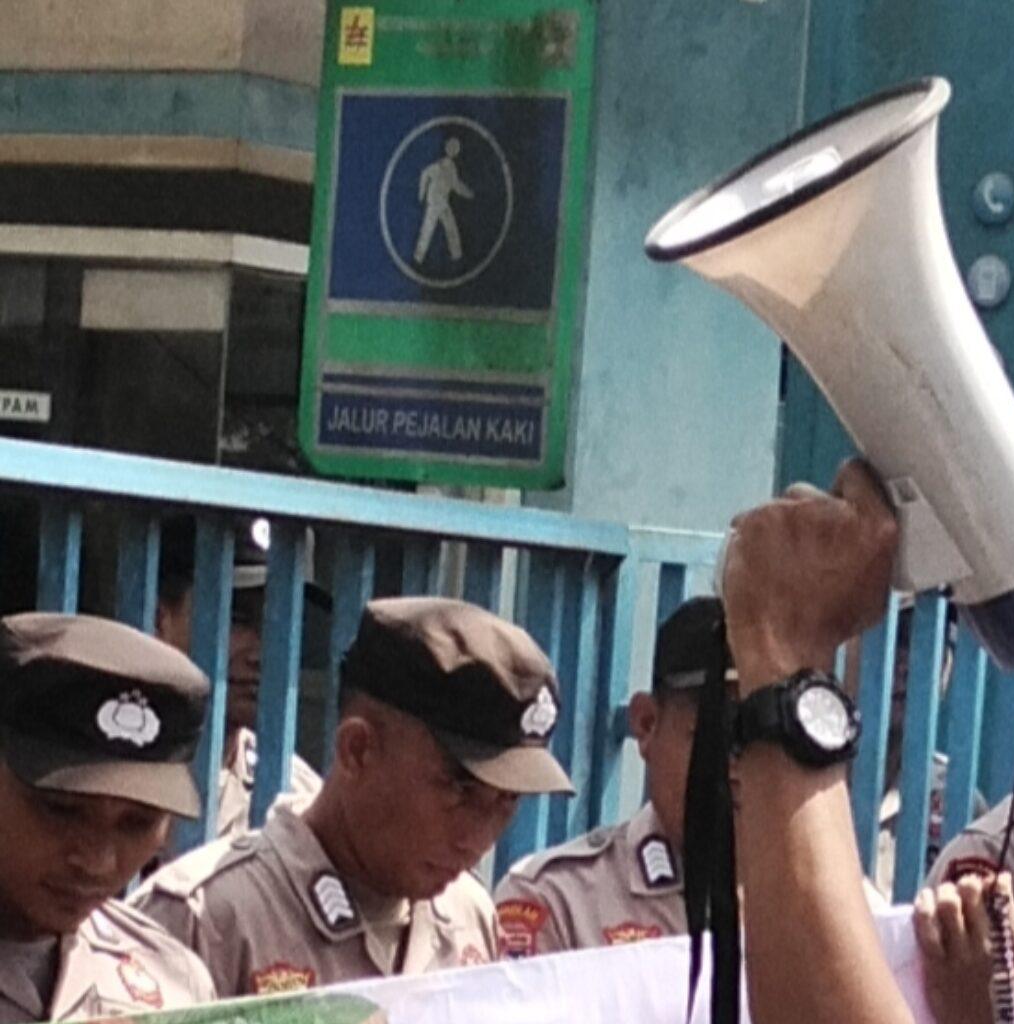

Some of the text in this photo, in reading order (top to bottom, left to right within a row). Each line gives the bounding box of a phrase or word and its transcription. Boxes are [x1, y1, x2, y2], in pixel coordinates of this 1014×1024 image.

[327, 405, 535, 446] JALUR PEJALAN KAKI
